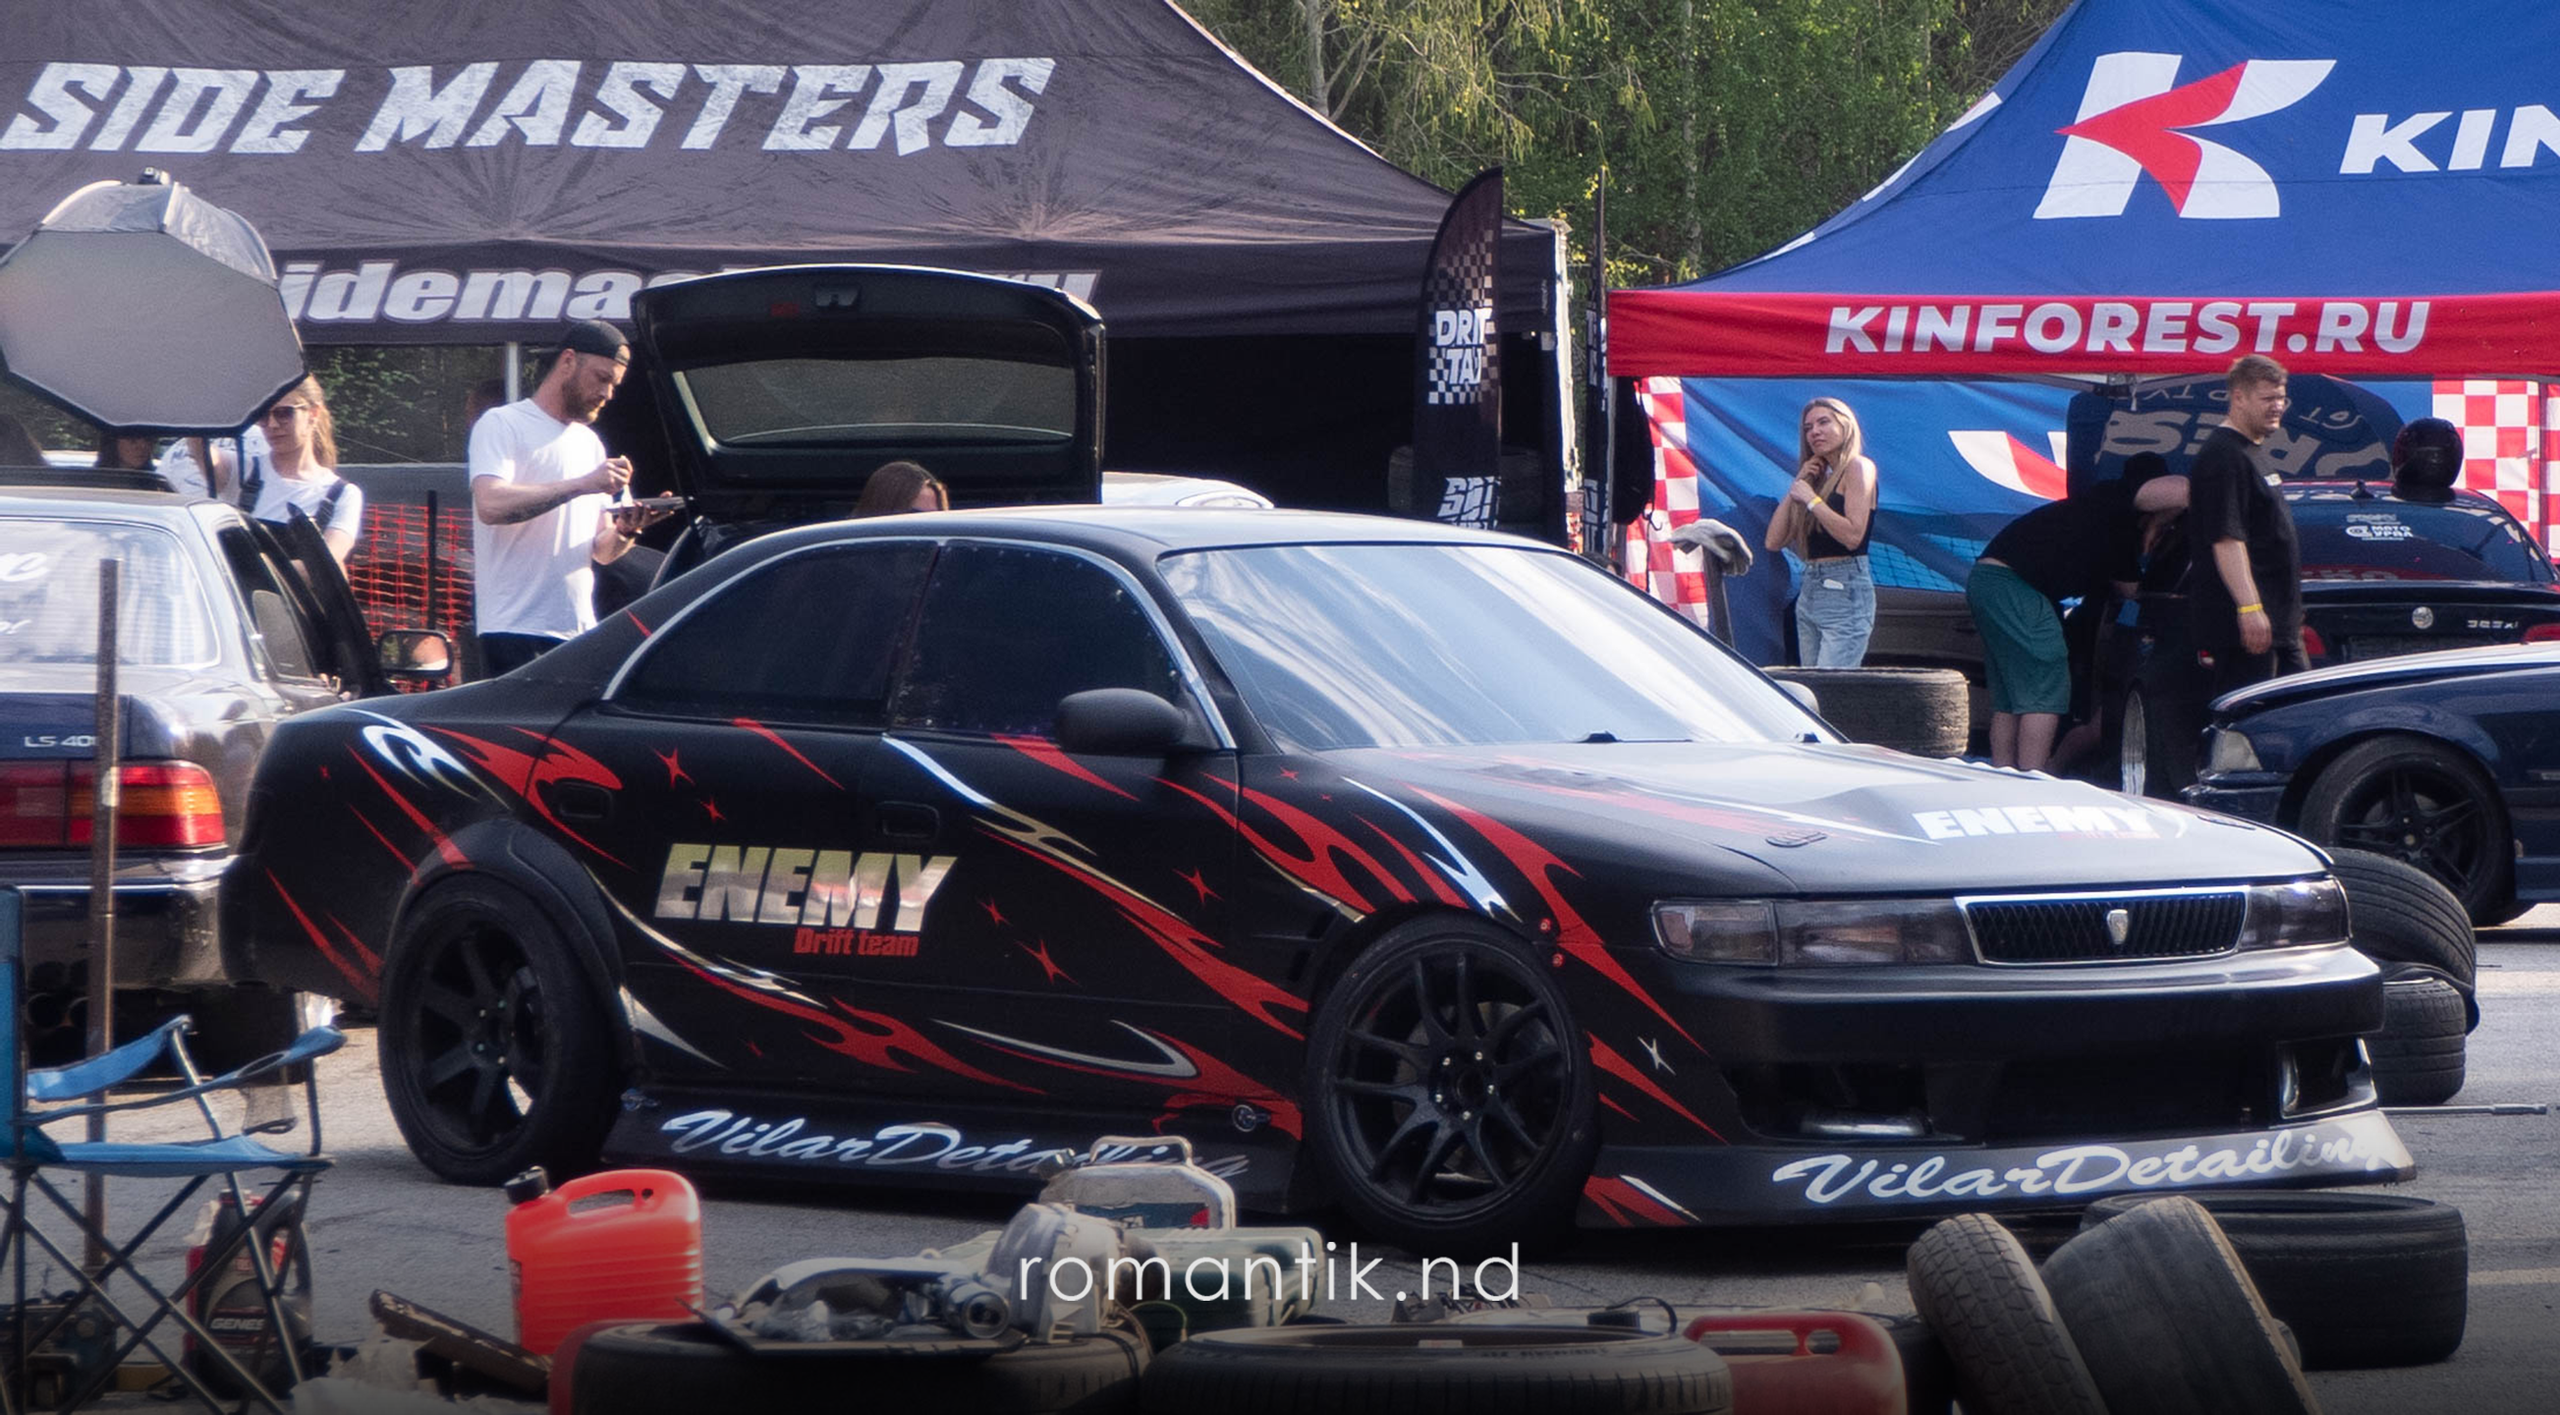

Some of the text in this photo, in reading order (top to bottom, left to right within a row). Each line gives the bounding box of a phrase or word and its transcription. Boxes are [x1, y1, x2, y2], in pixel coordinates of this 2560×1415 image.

[1, 57, 1057, 156] SIDE MASTERS
[1825, 300, 2431, 355] KINFOREST.RU
[24, 735, 57, 747] LS
[1911, 806, 2154, 840] ENEMY
[654, 843, 957, 931] ENEMY
[794, 926, 919, 957] Drift team
